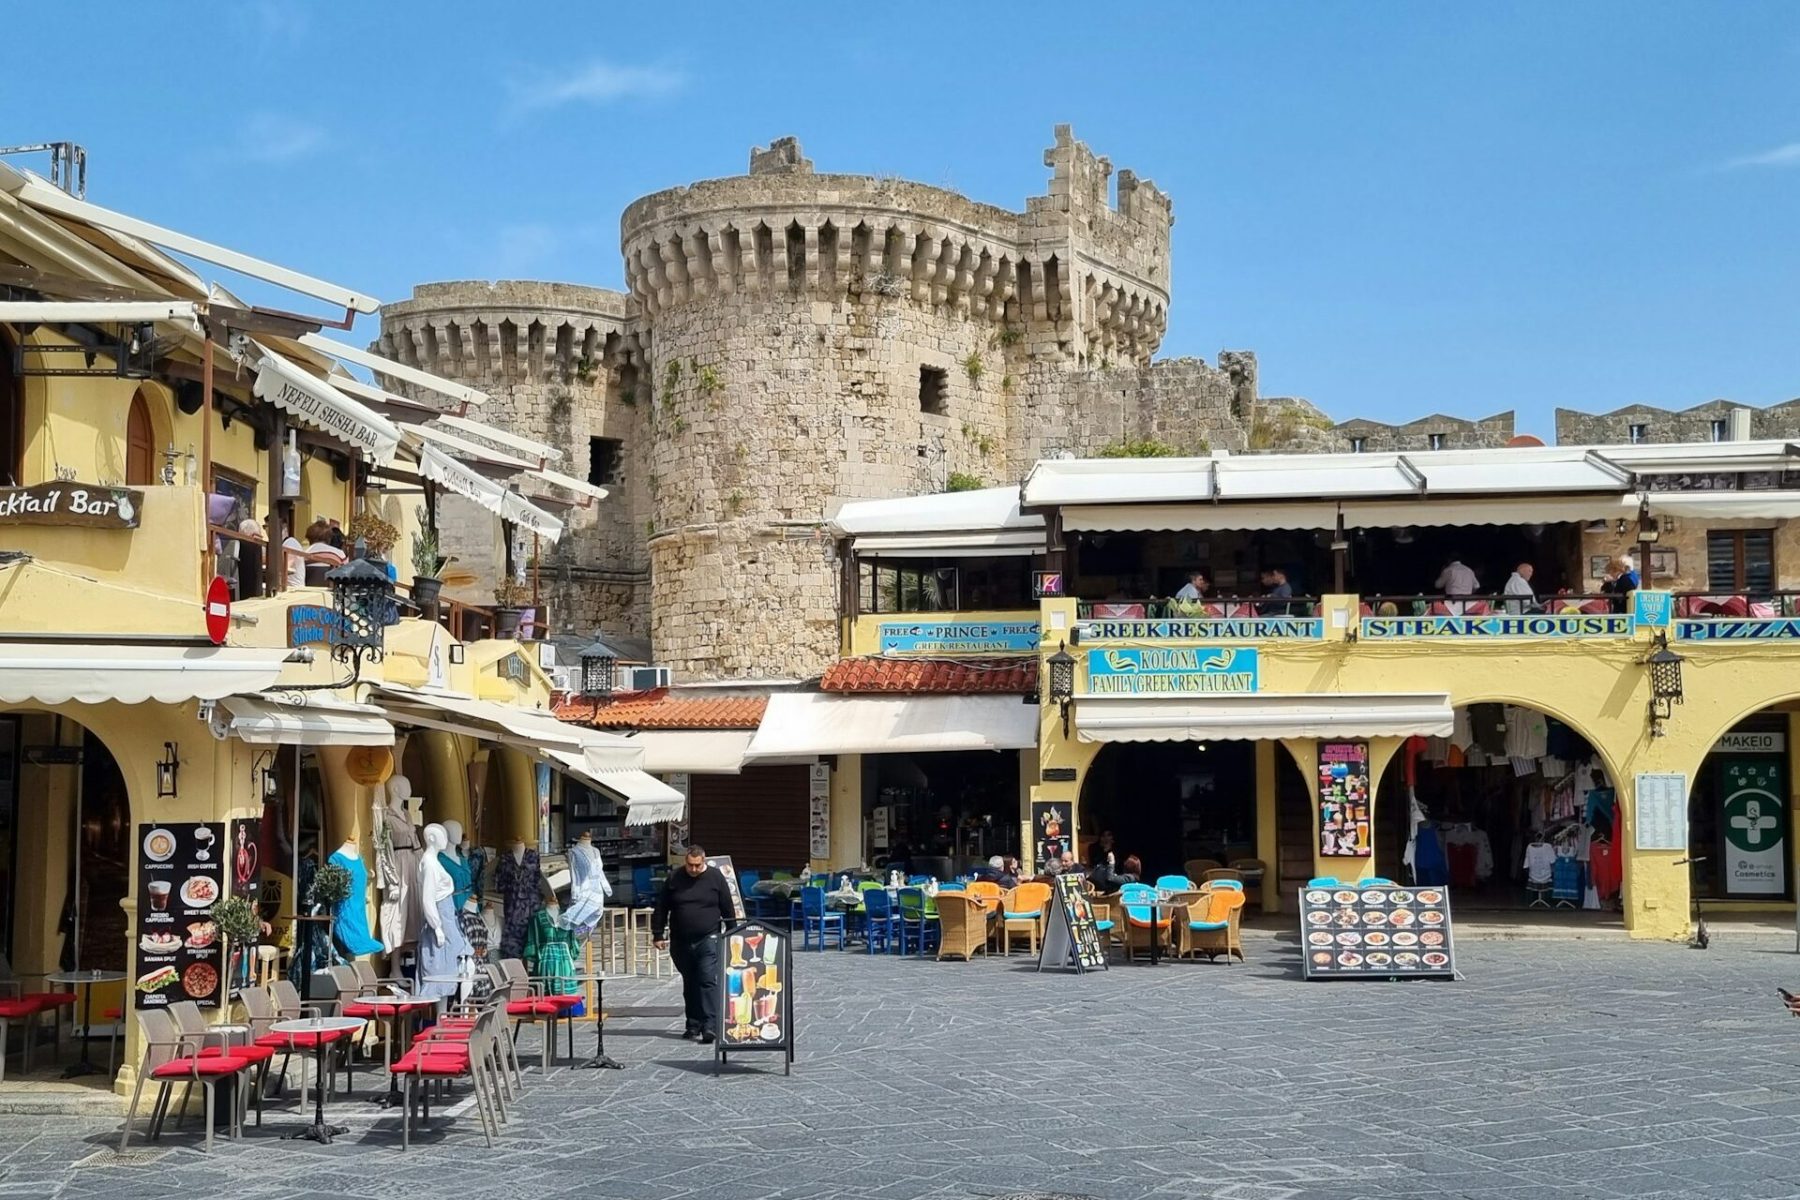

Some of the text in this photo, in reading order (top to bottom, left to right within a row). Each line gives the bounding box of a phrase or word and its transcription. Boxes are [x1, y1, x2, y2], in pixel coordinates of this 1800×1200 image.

[277, 383, 378, 447] NEFELI SHISHA BAR
[69, 490, 117, 516] Bar
[884, 627, 909, 636] FREE
[936, 626, 988, 638] PRINCE
[1003, 626, 1029, 635] FREE
[1089, 621, 1315, 638] GREEK RESTAURANT
[1369, 618, 1628, 636] STEAK HOUSE
[1681, 622, 1800, 639] PIZZA
[914, 641, 1009, 650] GREEK RESTAURANT
[1140, 651, 1199, 670] KOLONA
[1092, 674, 1252, 693] FAMILY GREEK RESTAURANT
[1734, 870, 1776, 878] Cosmetics
